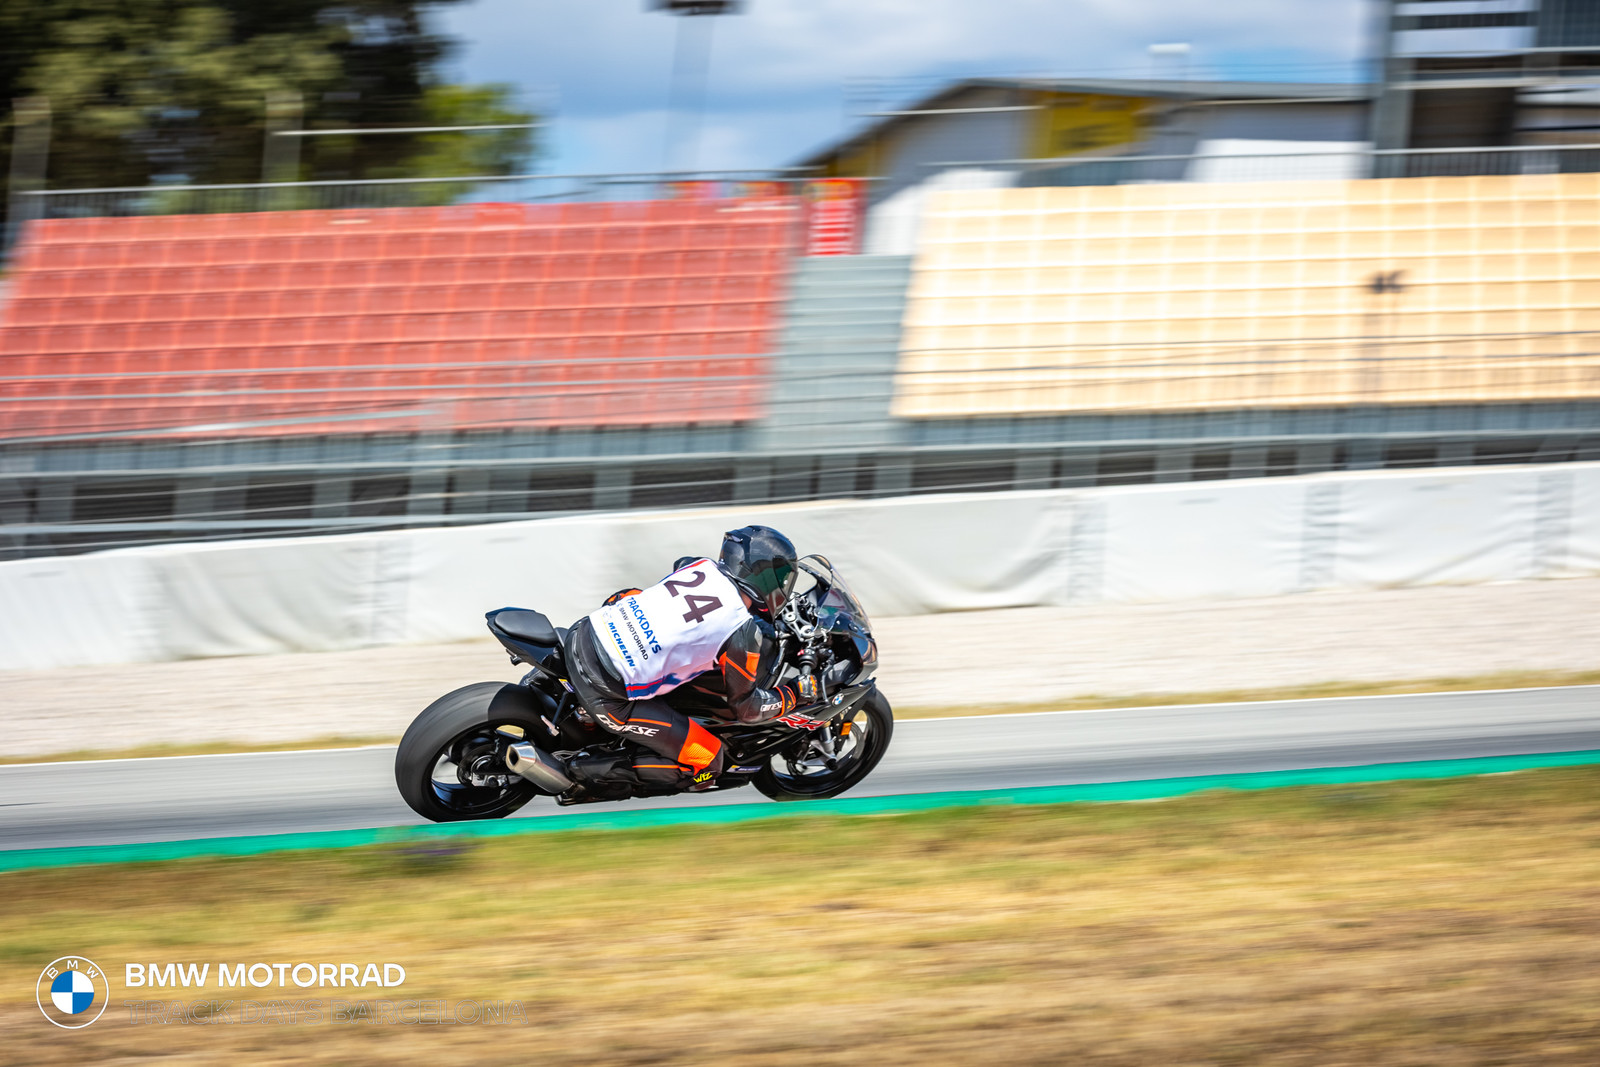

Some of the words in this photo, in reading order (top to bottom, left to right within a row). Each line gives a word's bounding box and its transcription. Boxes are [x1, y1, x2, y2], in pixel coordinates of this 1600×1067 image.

[664, 570, 723, 624] 24
[608, 622, 636, 667] MICHELIN
[619, 607, 630, 621] BMW
[626, 621, 649, 661] MOTORRAD
[626, 597, 662, 654] TRACKDAYS
